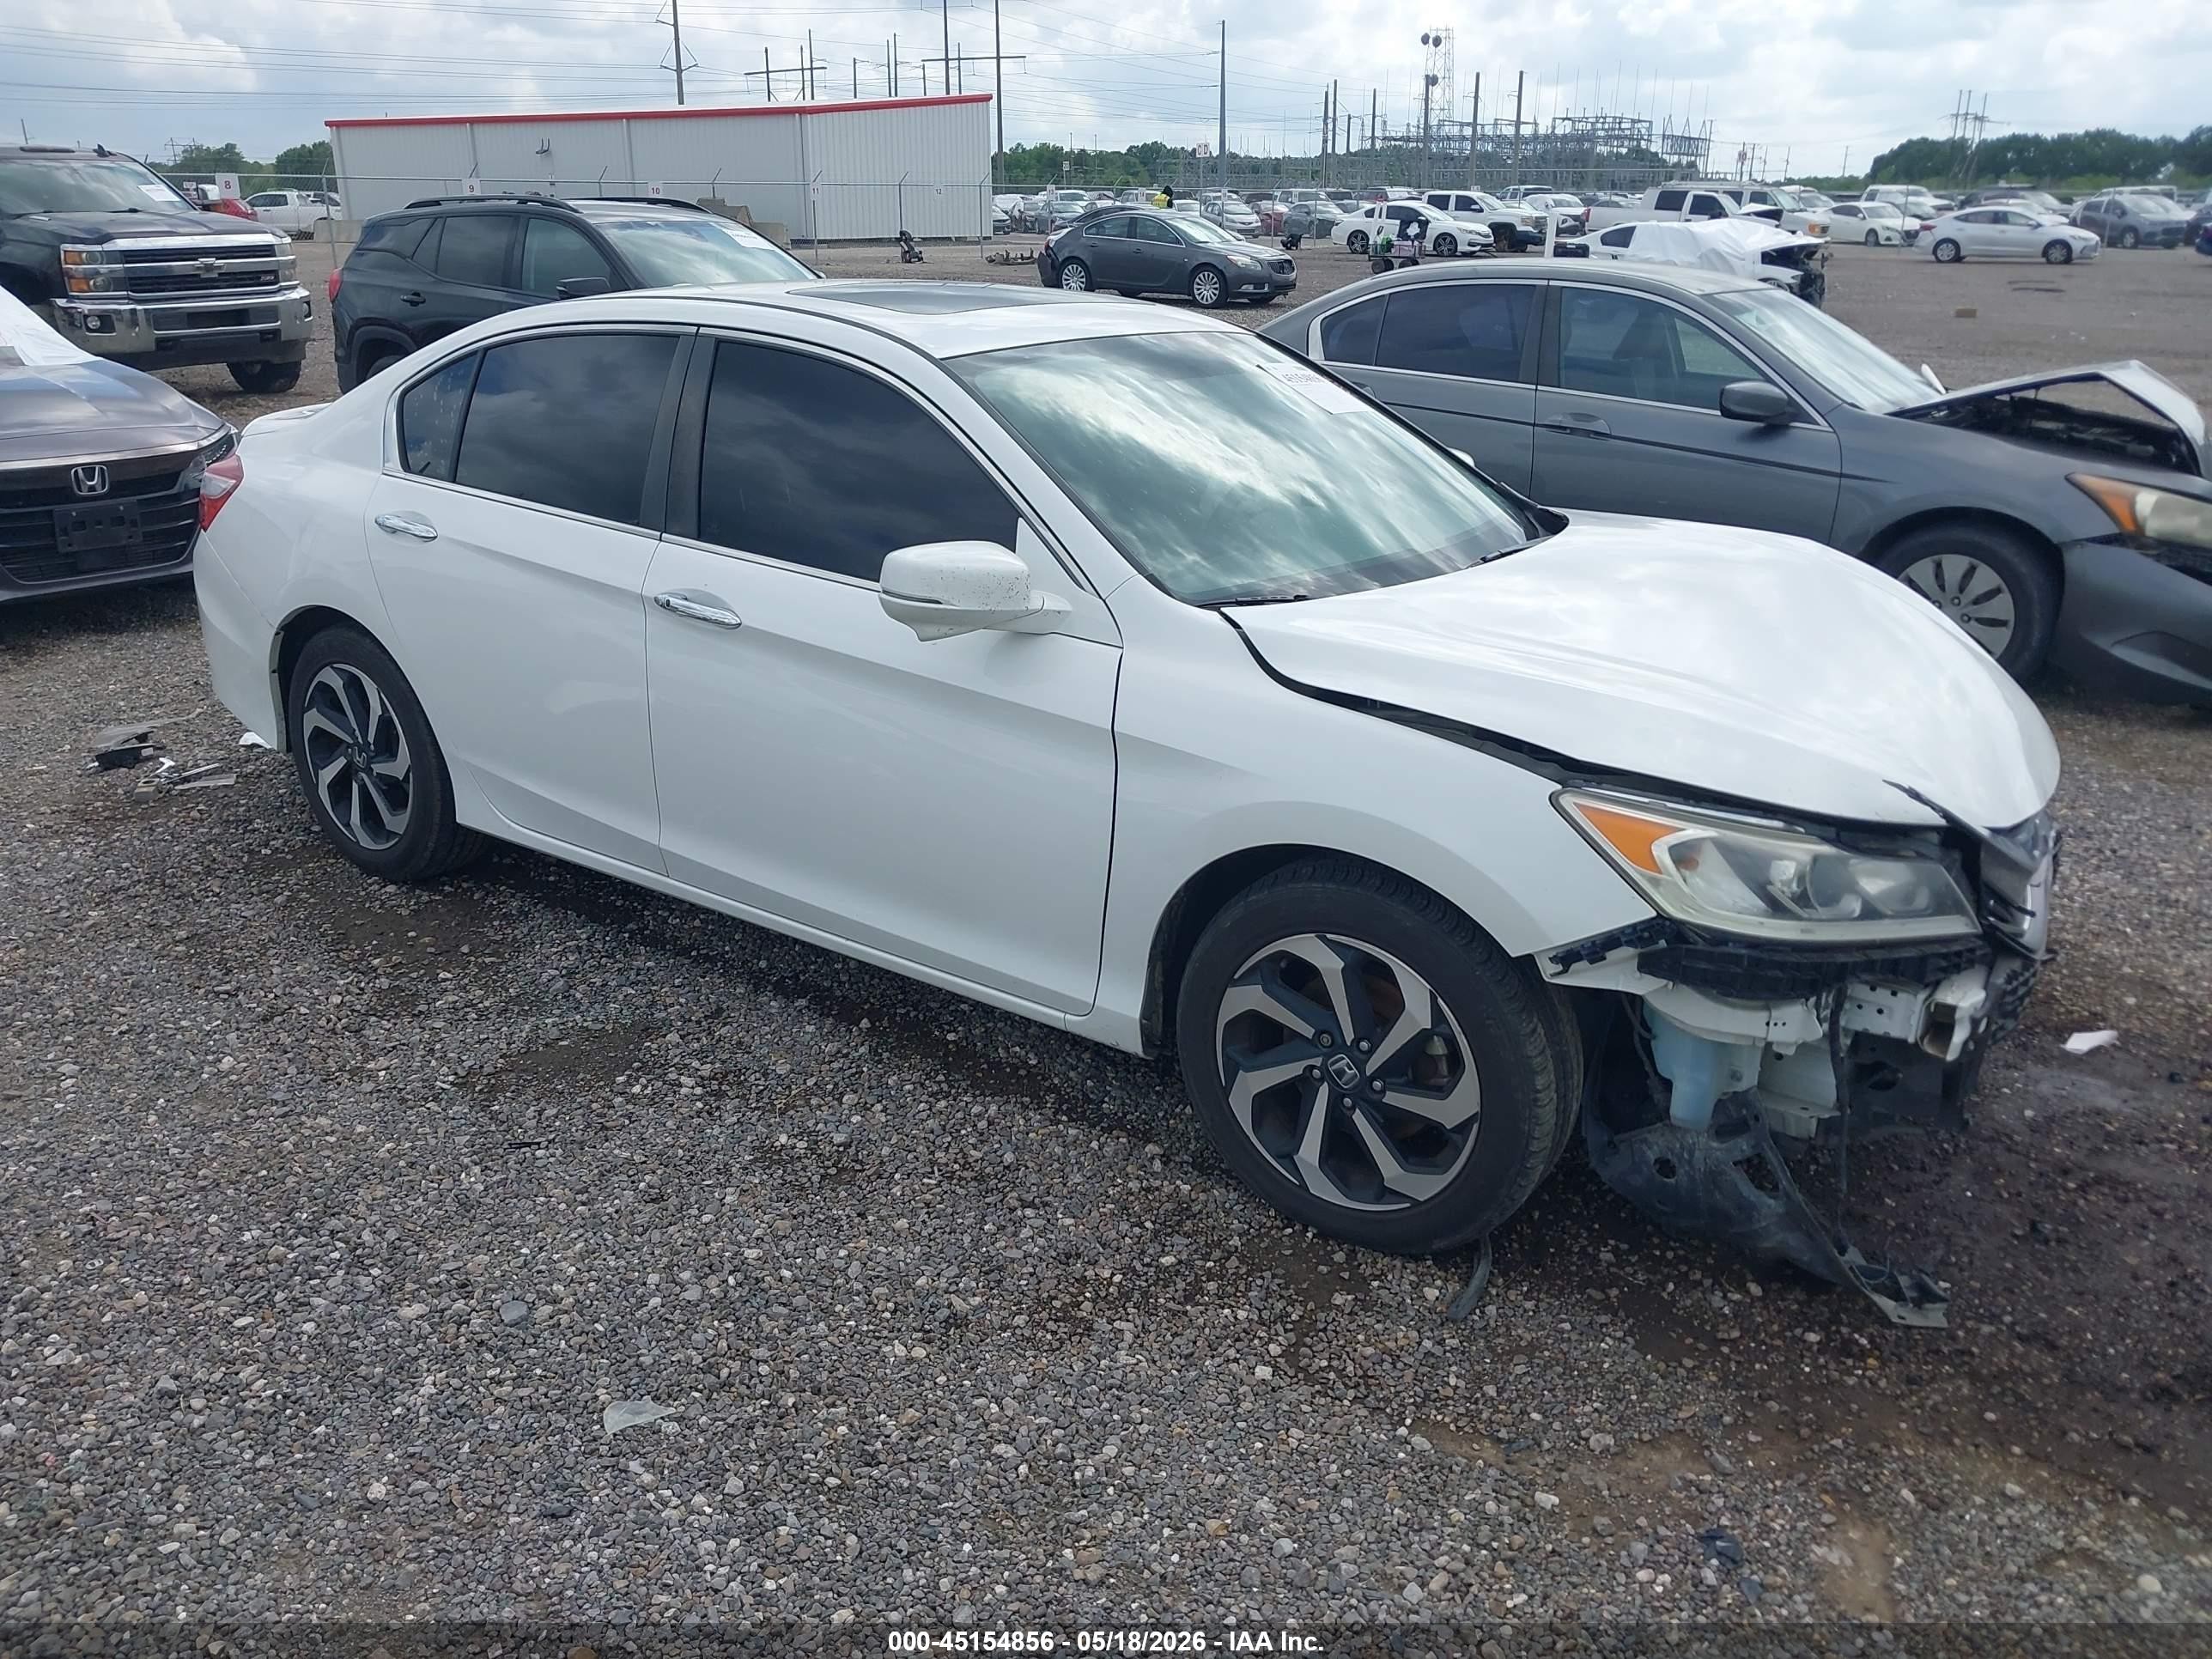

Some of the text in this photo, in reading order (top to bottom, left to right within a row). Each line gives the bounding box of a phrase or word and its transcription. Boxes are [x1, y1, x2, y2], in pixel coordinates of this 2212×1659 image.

[223, 179, 232, 190] 8
[468, 184, 475, 193] 9
[651, 186, 660, 195] 10
